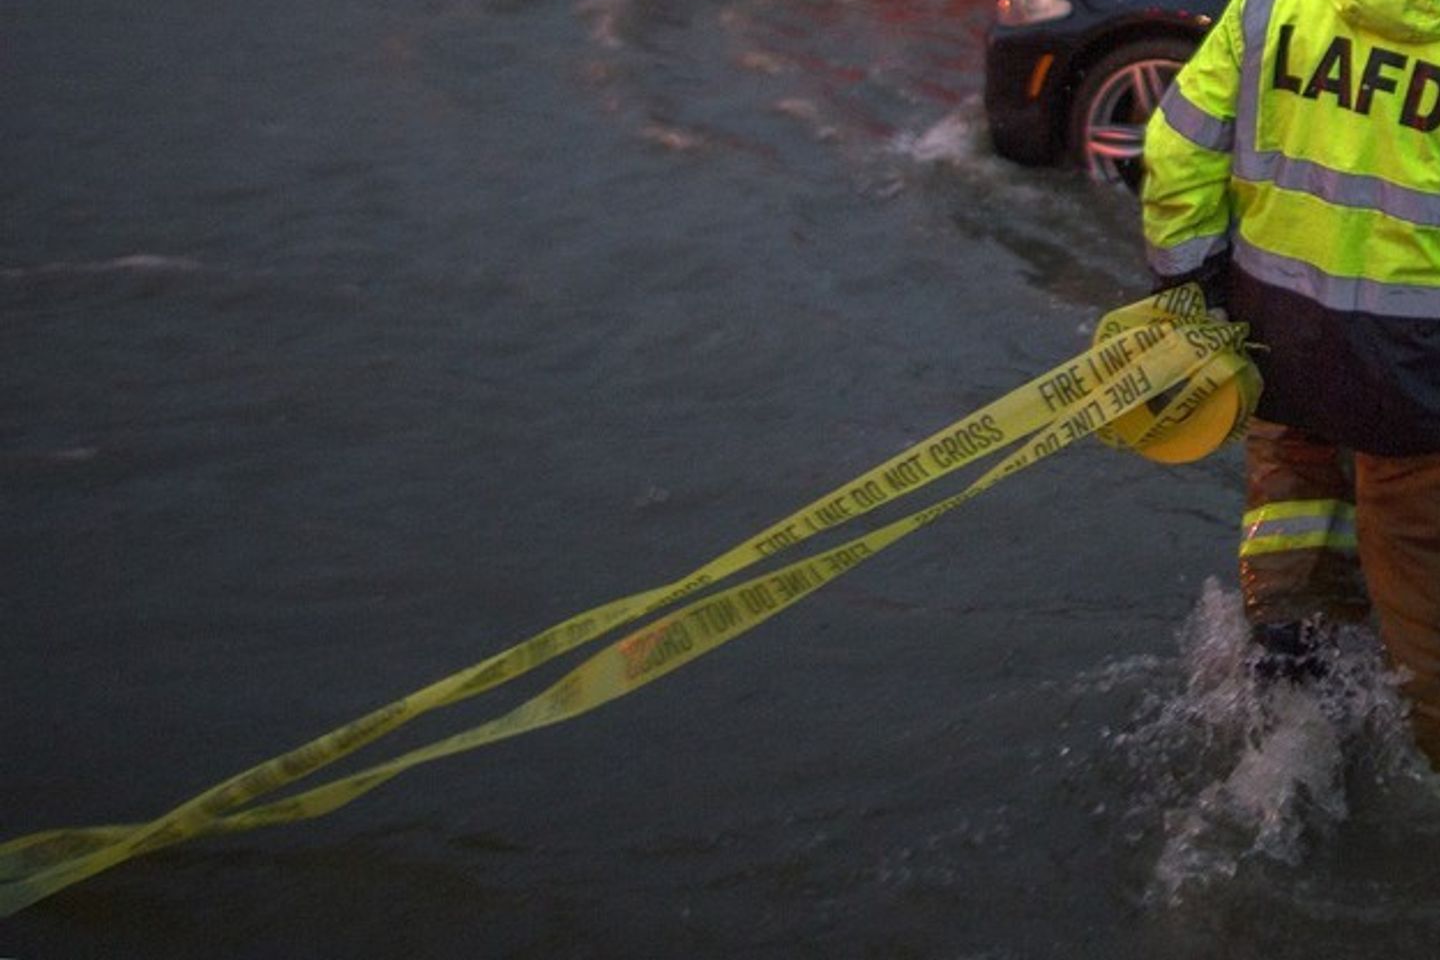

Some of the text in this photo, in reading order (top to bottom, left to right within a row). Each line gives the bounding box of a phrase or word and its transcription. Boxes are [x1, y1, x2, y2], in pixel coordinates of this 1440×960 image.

[1038, 365, 1091, 411] FIRE
[1104, 367, 1152, 413] FIRE
[1059, 403, 1106, 439] LINE
[854, 480, 887, 508] DO
[884, 453, 931, 492] NOT
[928, 415, 1004, 469] CROSS
